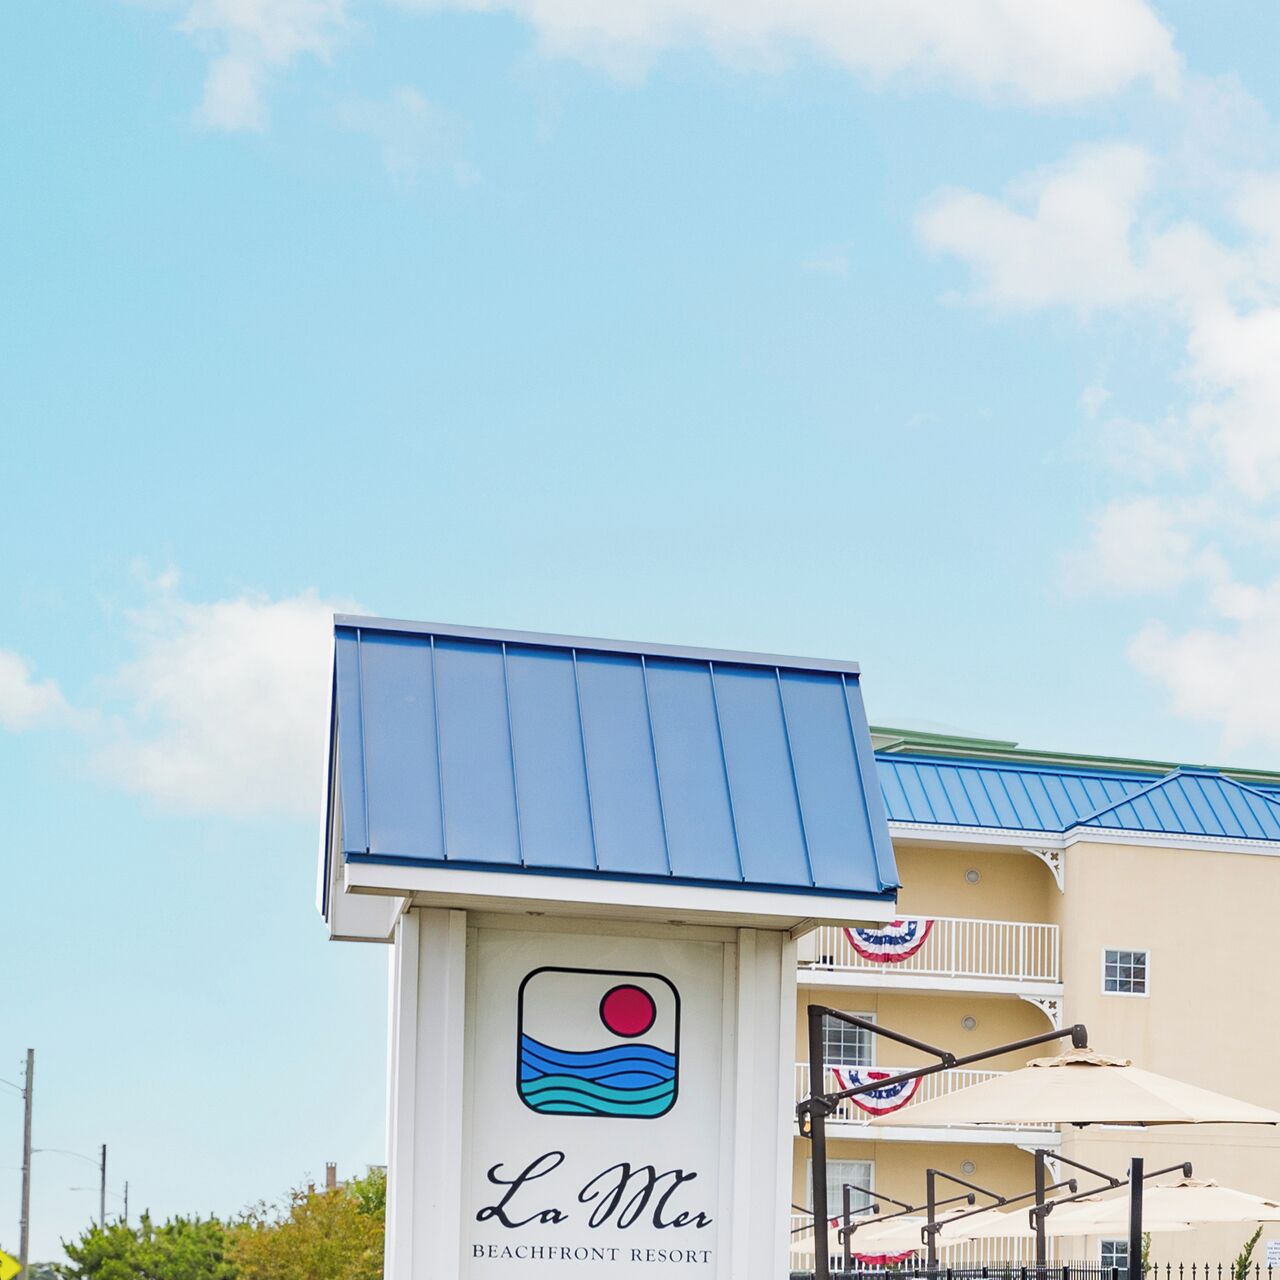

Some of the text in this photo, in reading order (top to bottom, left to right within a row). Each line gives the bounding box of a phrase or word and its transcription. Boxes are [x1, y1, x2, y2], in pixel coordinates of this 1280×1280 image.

[476, 1150, 713, 1229] La Mer
[472, 1244, 713, 1264] BEACHFRONT RESORT
